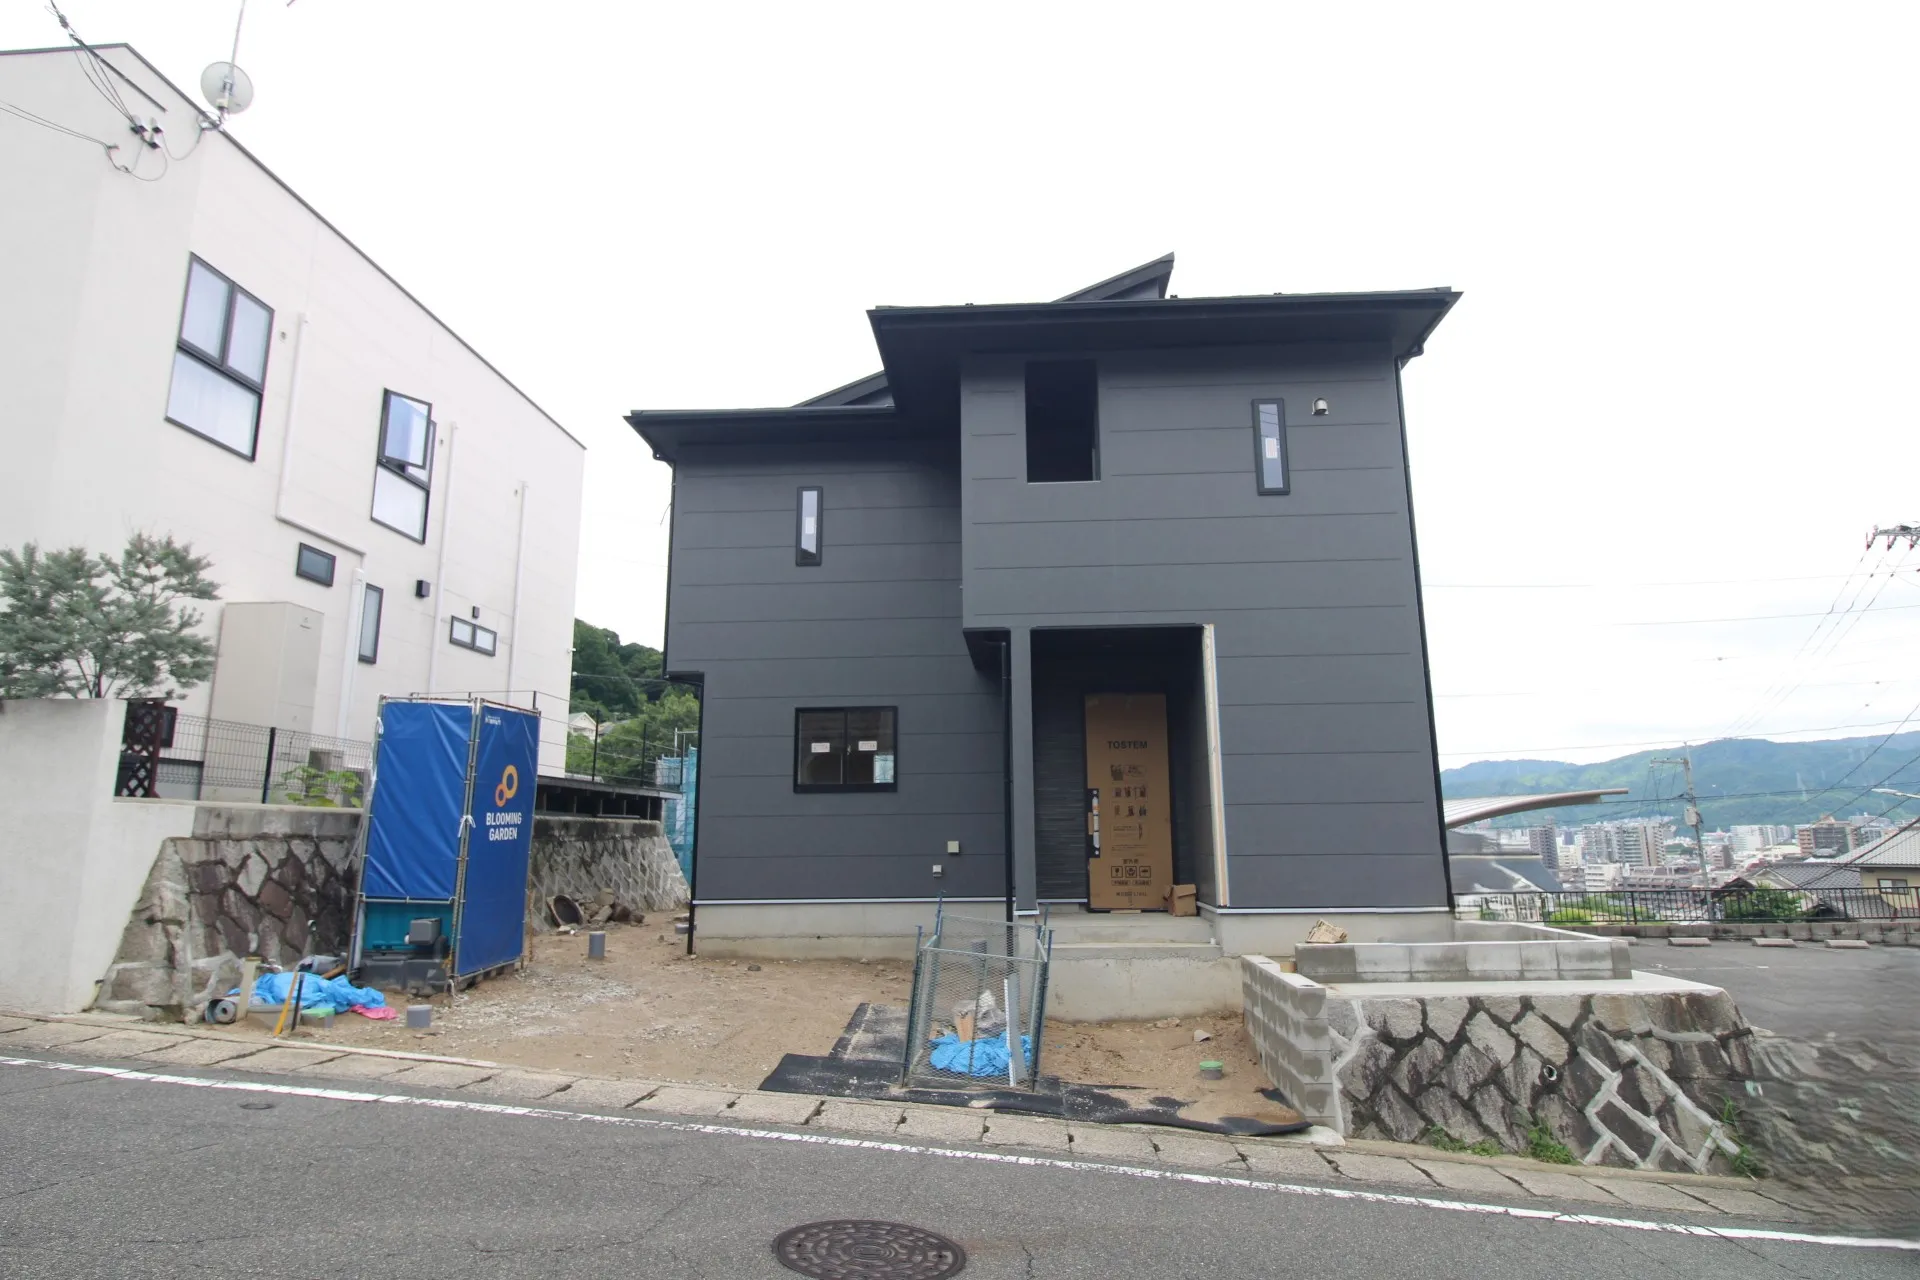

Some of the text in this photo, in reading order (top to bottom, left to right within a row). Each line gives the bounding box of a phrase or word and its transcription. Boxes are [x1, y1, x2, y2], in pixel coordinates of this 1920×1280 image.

[1107, 741, 1148, 750] TOSTEM
[486, 812, 522, 826] BLOOMING
[489, 827, 518, 841] GARDEN
